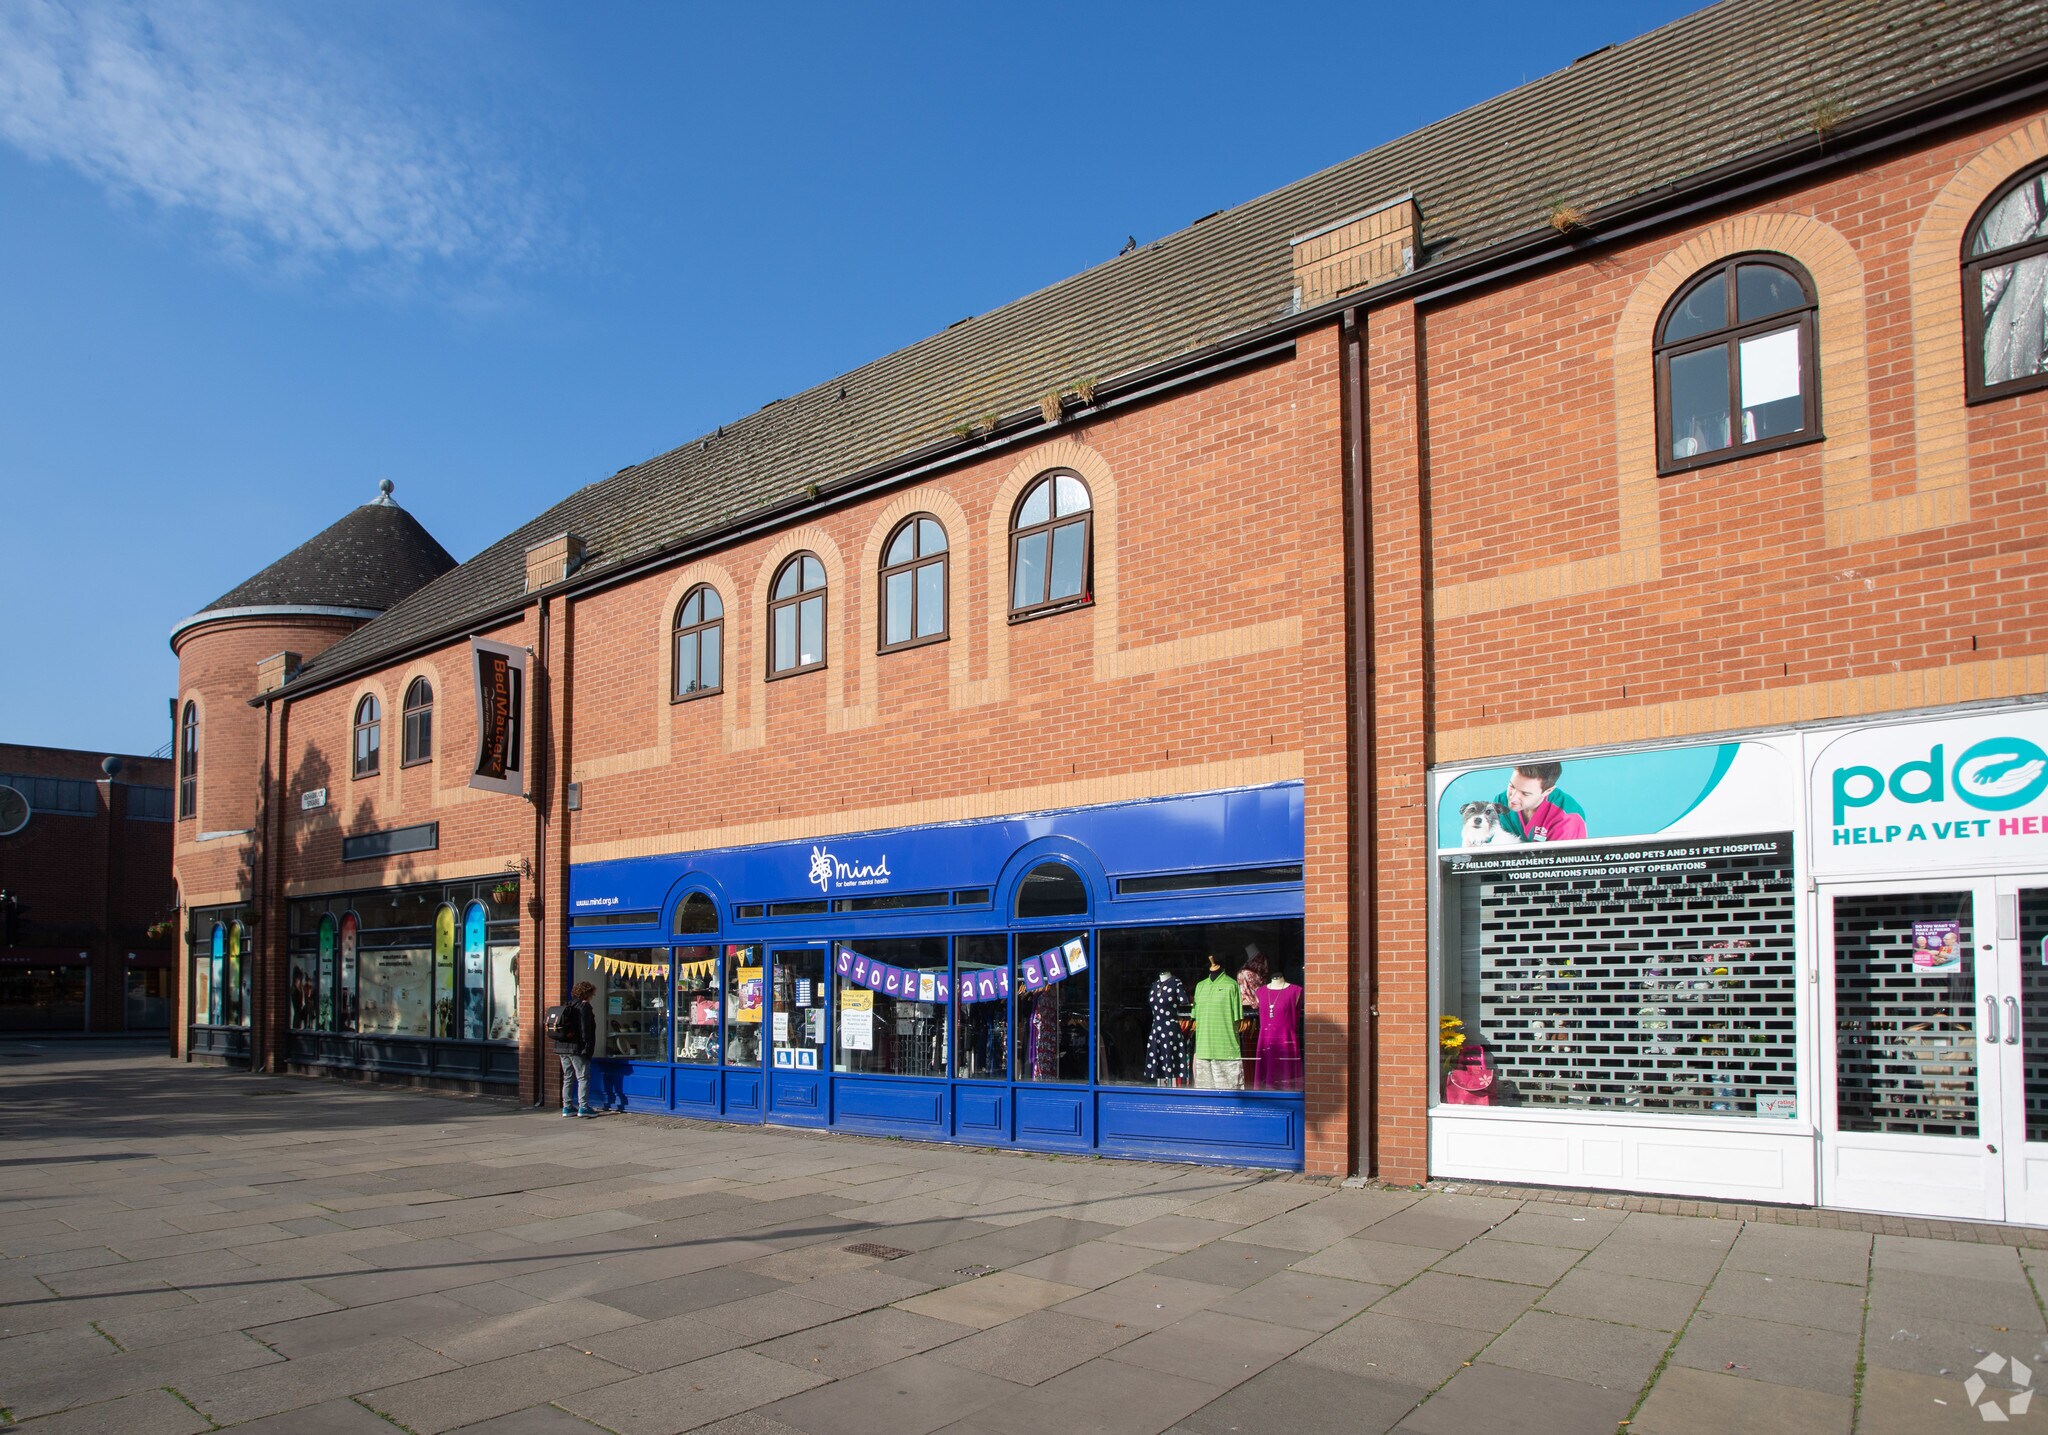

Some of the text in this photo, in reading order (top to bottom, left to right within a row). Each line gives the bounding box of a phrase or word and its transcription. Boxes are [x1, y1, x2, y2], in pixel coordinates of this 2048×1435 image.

[492, 659, 508, 772] Bed Matterz
[1832, 825, 1902, 846] HELP
[1907, 823, 1927, 841] A
[1931, 819, 1991, 840] VET
[835, 854, 891, 880] mind
[1452, 842, 1777, 870] 2.7 MILLION TREATMENTS ANNUALLY, 470,000 PETS AND 51 PET HOSPITALS
[874, 877, 889, 885] health
[1508, 862, 1707, 880] YOUR DONATIONS FUND OUR PET OPERATIONS
[575, 896, 619, 907] www.mind.org.uk
[839, 952, 915, 995] Stock
